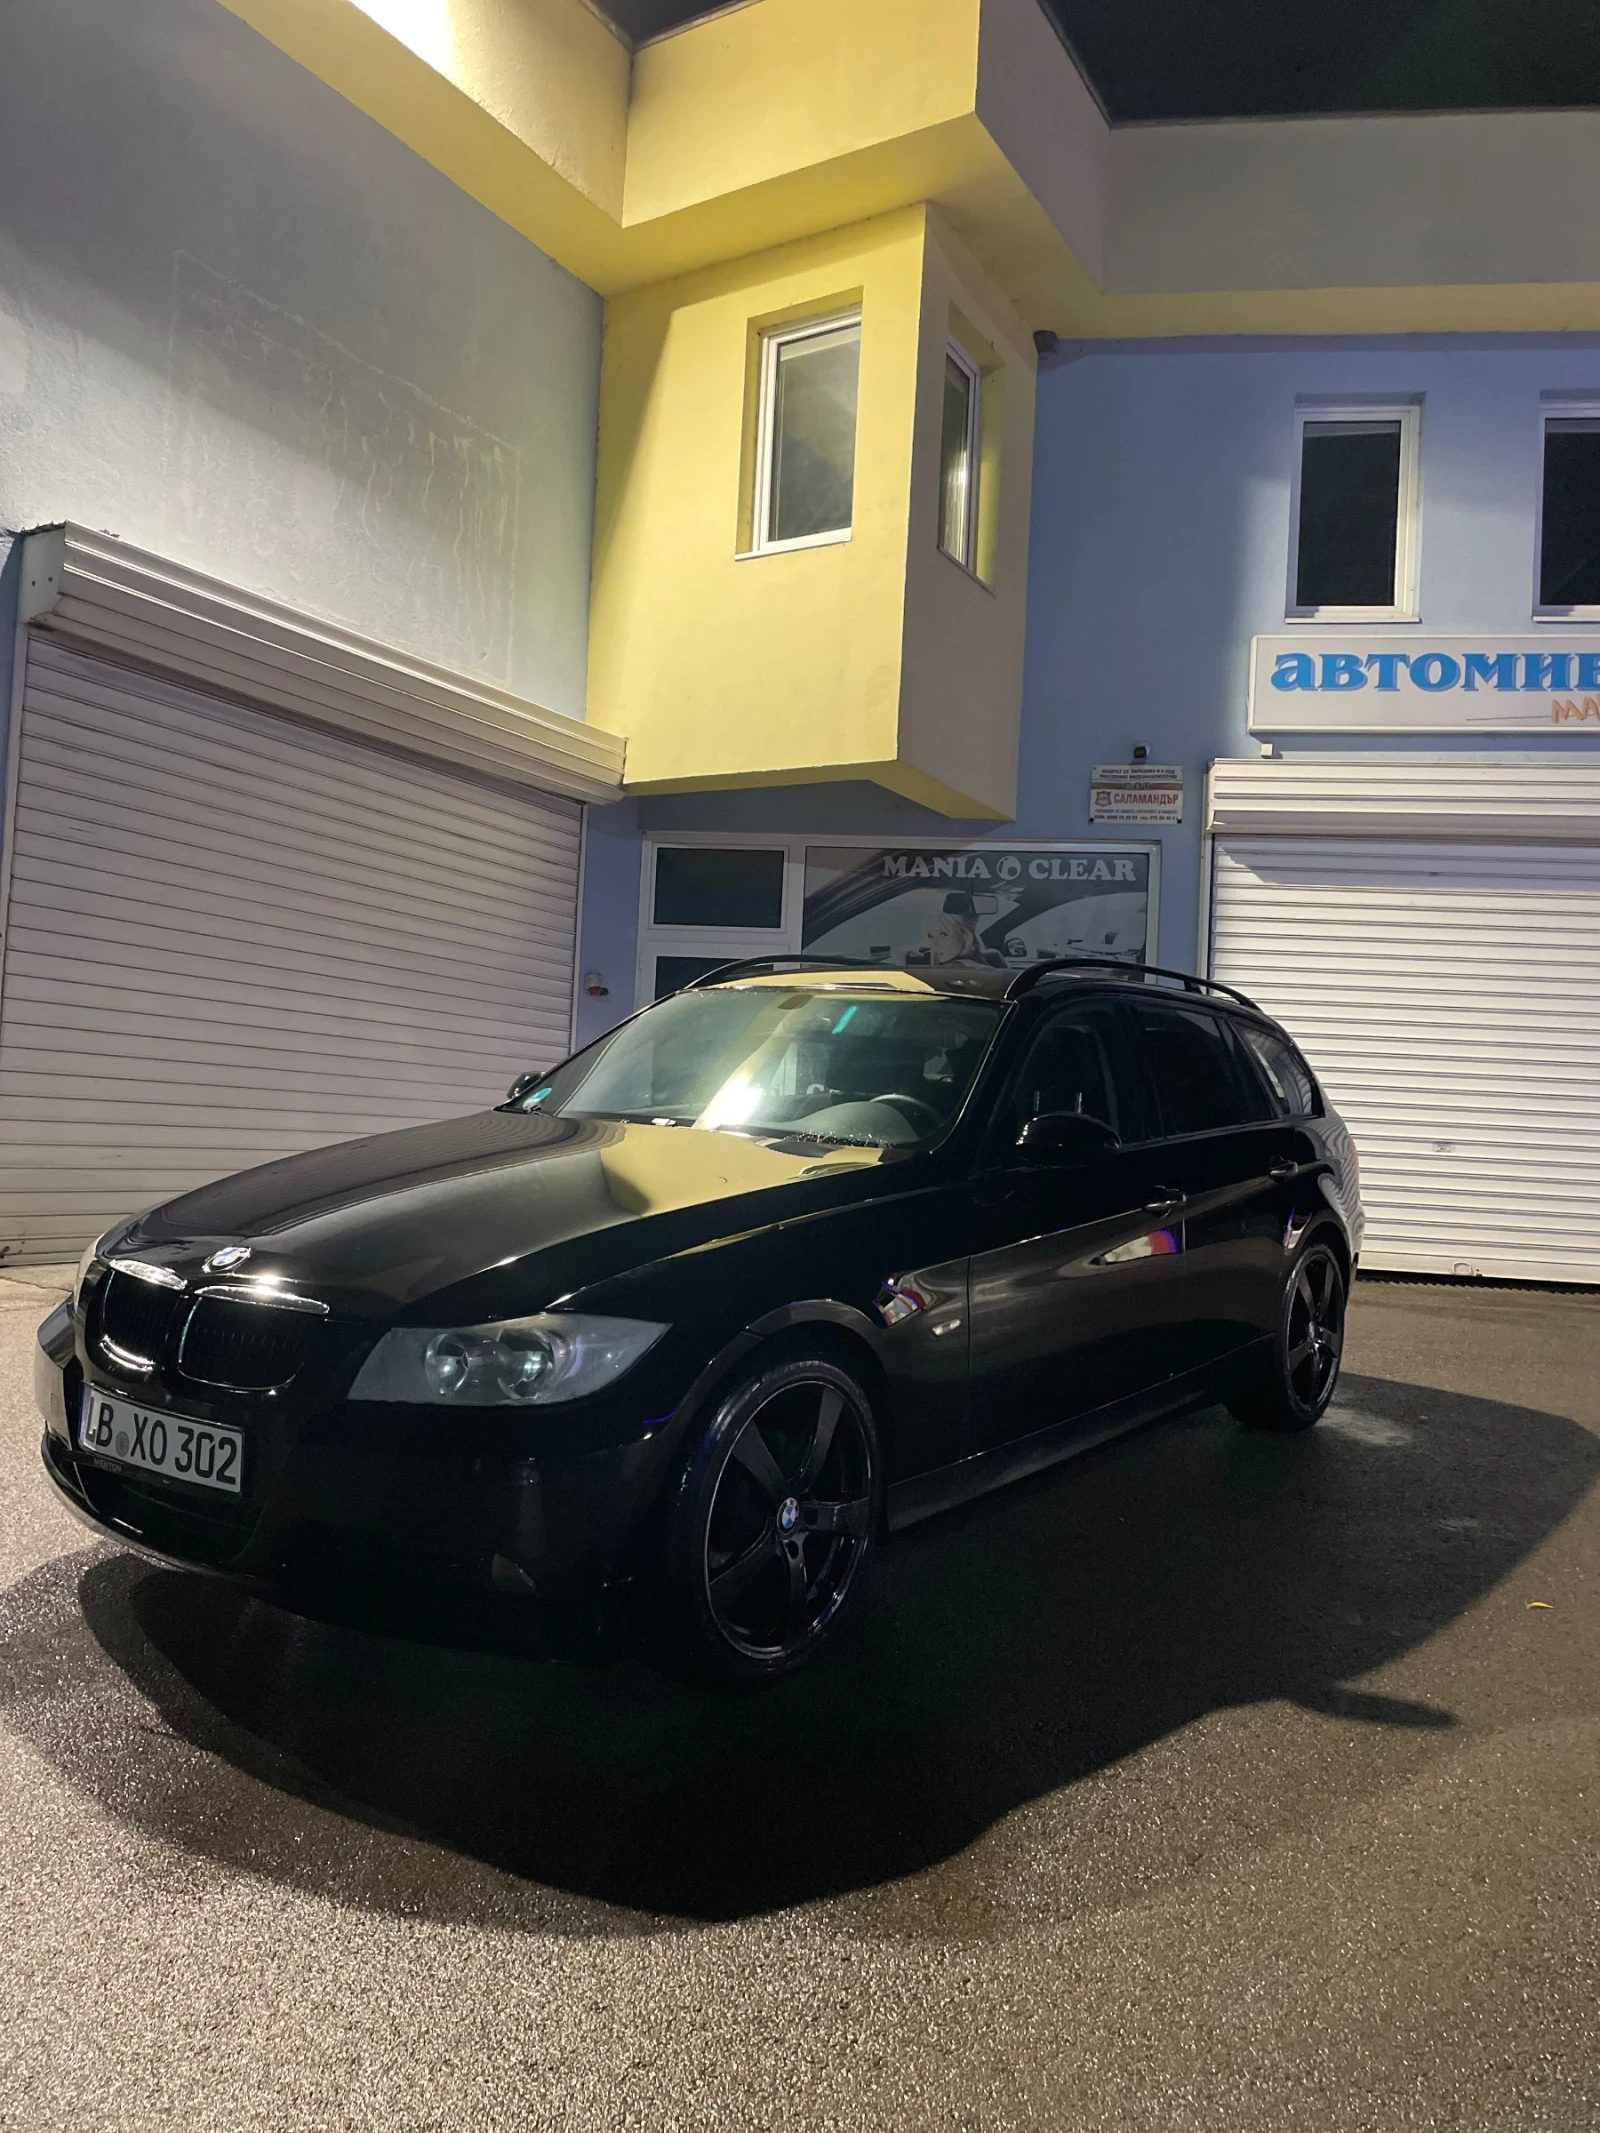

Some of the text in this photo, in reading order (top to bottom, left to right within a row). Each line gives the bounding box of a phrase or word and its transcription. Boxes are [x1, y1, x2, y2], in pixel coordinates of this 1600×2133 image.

[1114, 793, 1179, 806] САЛАМАНДЪР
[882, 856, 1136, 881] MANIA CLEAR
[130, 1413, 167, 1465] XO
[174, 1425, 238, 1485] 302
